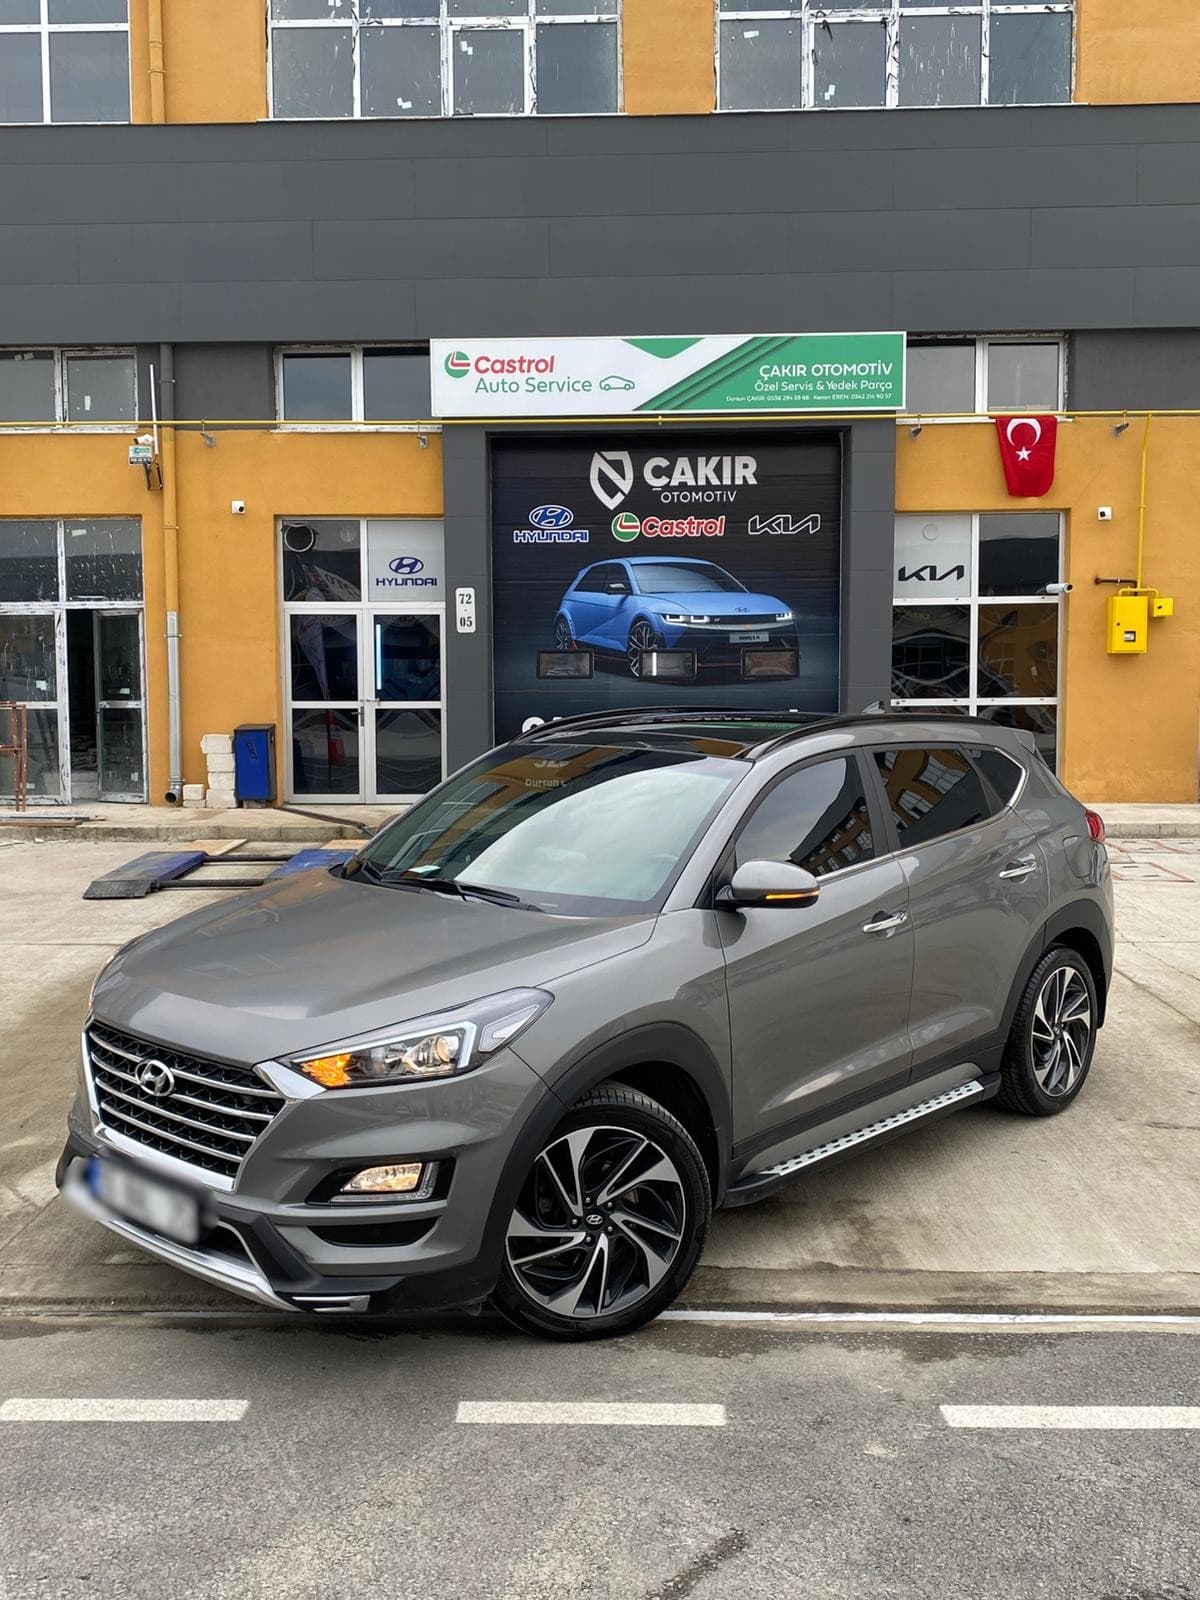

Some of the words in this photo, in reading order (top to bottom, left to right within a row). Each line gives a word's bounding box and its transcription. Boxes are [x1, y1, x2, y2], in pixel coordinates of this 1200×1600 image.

[474, 355, 555, 374] Castrol
[759, 364, 807, 381] ÇAKIR
[811, 360, 893, 376] OTOMOTİV
[475, 377, 520, 393] Auto
[525, 376, 593, 393] Service
[754, 379, 779, 392] Özel
[781, 380, 814, 391] Servis
[816, 381, 825, 391] &
[826, 379, 858, 391] Yedek
[860, 379, 893, 392] Parça
[642, 455, 758, 491] ÇAKIR
[641, 515, 726, 537] Castrol
[748, 513, 821, 535] KIA
[513, 530, 589, 543] HYUNDAI
[375, 577, 438, 587] HYUNDAI
[898, 565, 965, 582] KIA
[459, 593, 472, 605] 72
[459, 616, 473, 627] 05
